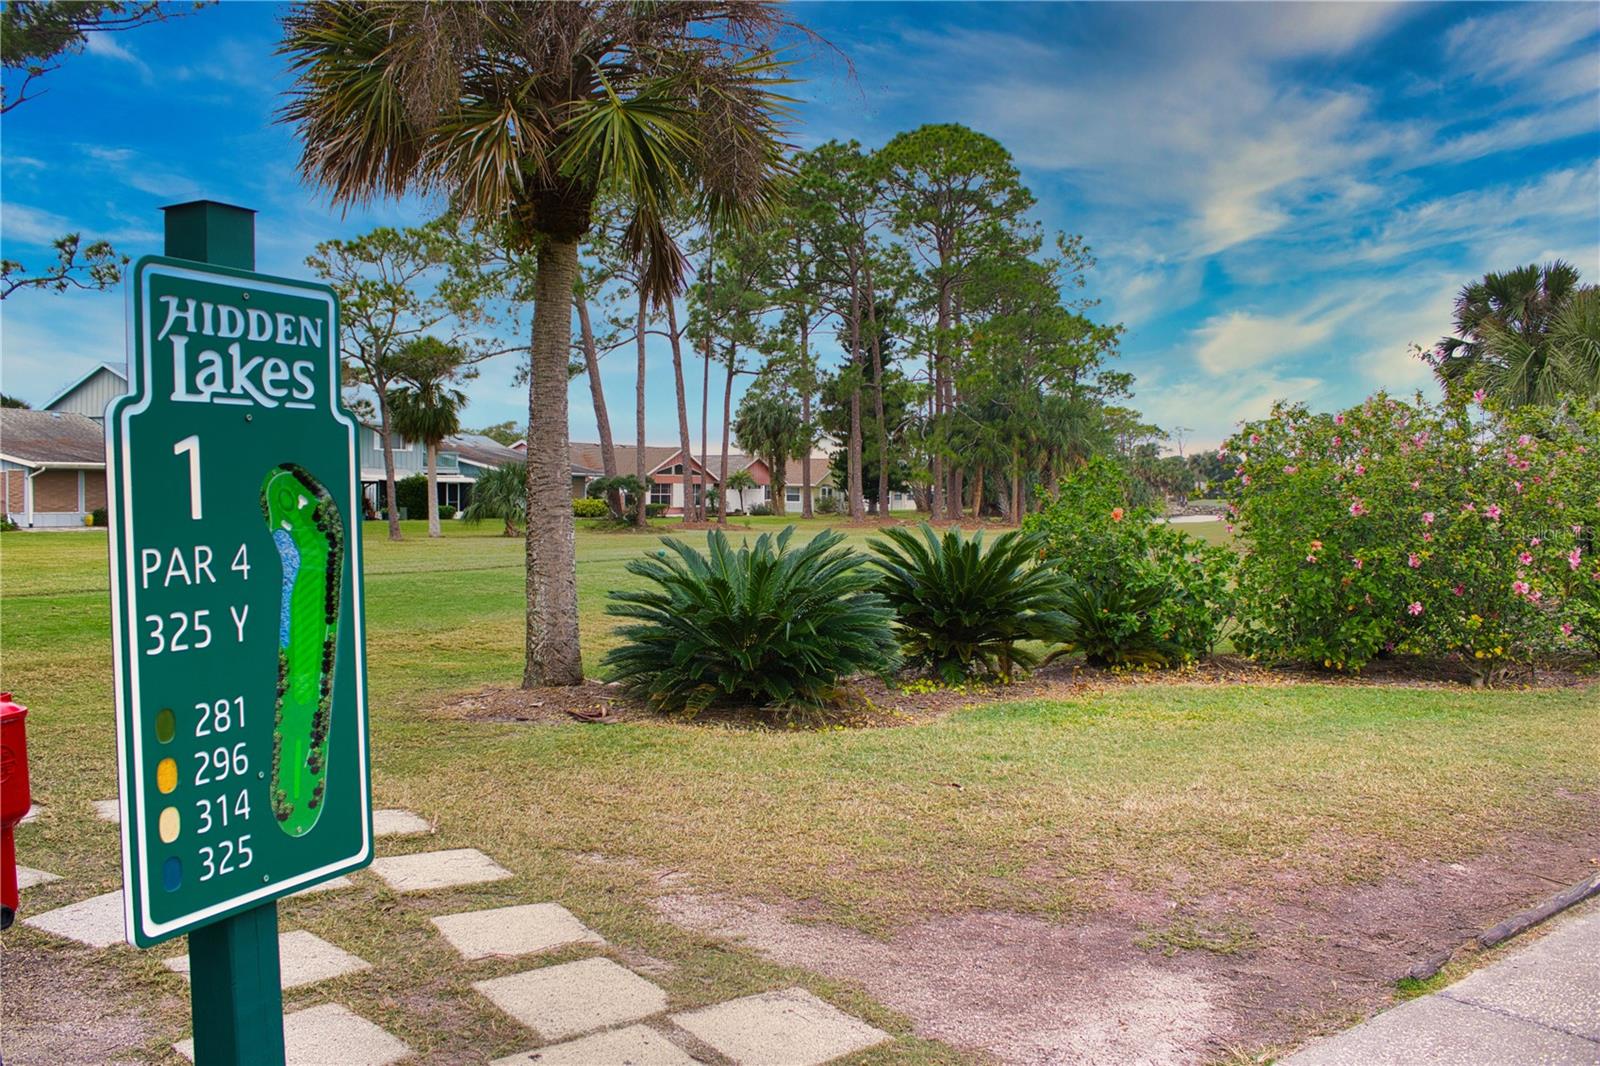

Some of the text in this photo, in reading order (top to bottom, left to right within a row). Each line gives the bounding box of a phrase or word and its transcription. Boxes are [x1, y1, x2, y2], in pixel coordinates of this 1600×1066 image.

[157, 295, 323, 348] HIDDEN
[170, 334, 316, 409] Lakes
[173, 434, 203, 520] 1
[141, 543, 251, 589] PAR 4
[145, 604, 249, 656] 325 Y
[194, 696, 246, 737] 281
[194, 742, 249, 786] 296
[196, 788, 251, 834] 314
[198, 834, 254, 882] 325
